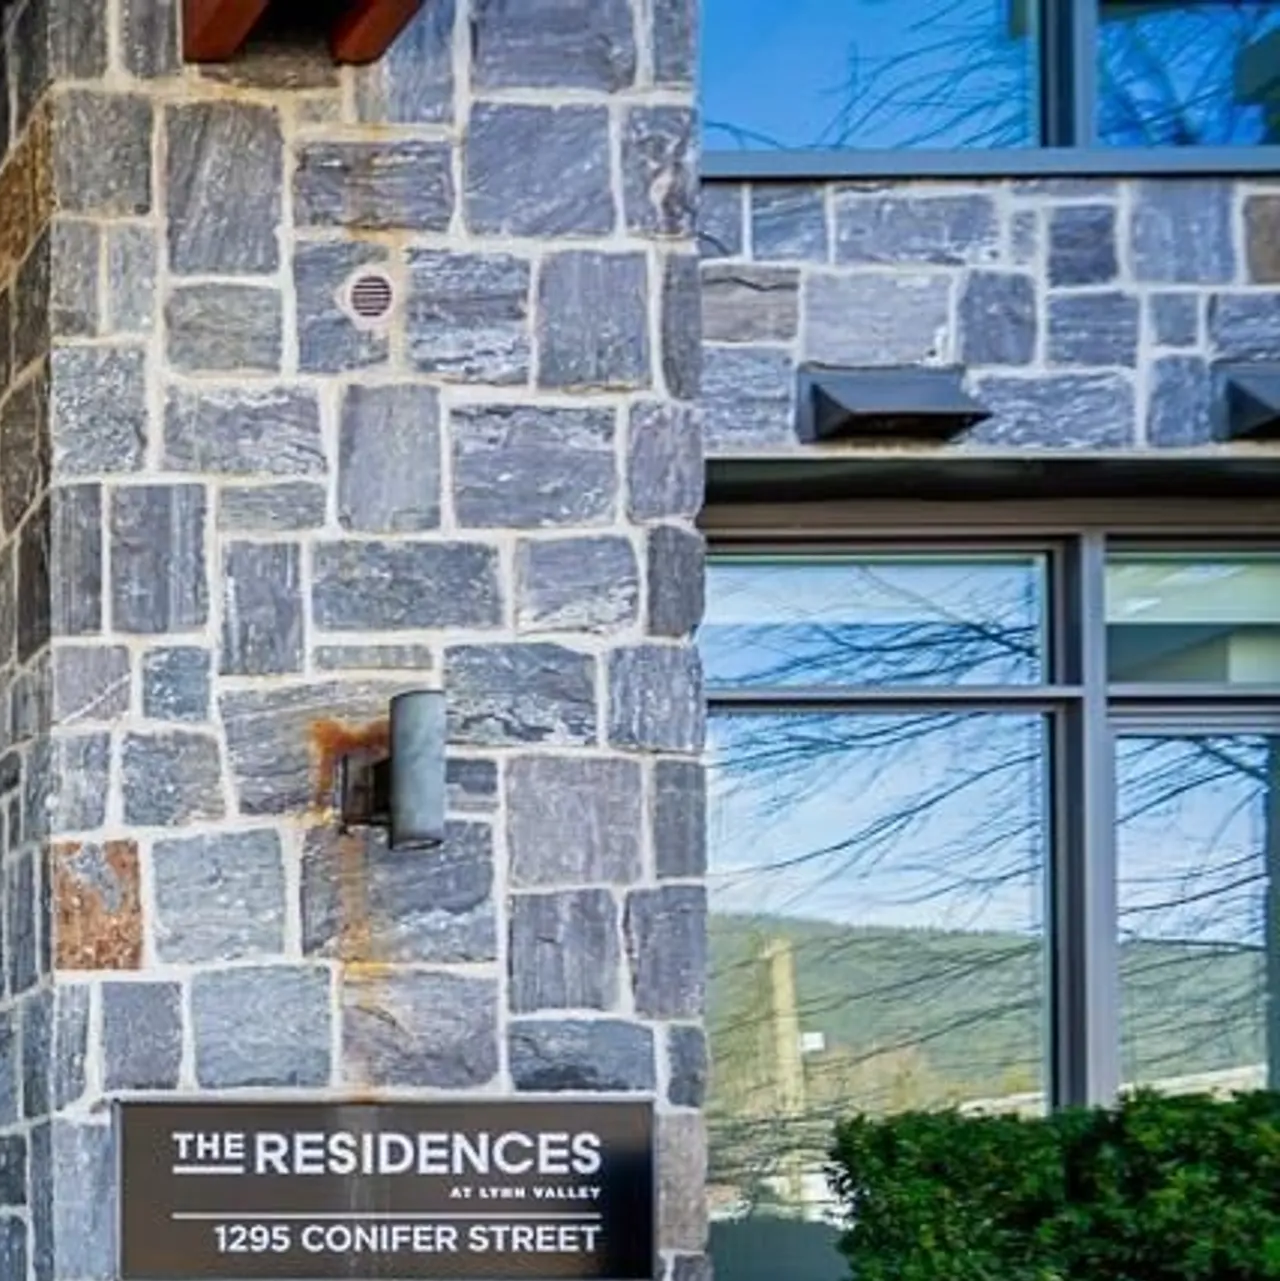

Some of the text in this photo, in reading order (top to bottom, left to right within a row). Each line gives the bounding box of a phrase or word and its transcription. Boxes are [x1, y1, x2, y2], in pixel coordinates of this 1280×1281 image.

[172, 1131, 602, 1175] THE RESIDENCES
[449, 1186, 602, 1199] AT LYNN VALLEY
[213, 1224, 602, 1254] 1295 CONIFER STREET
